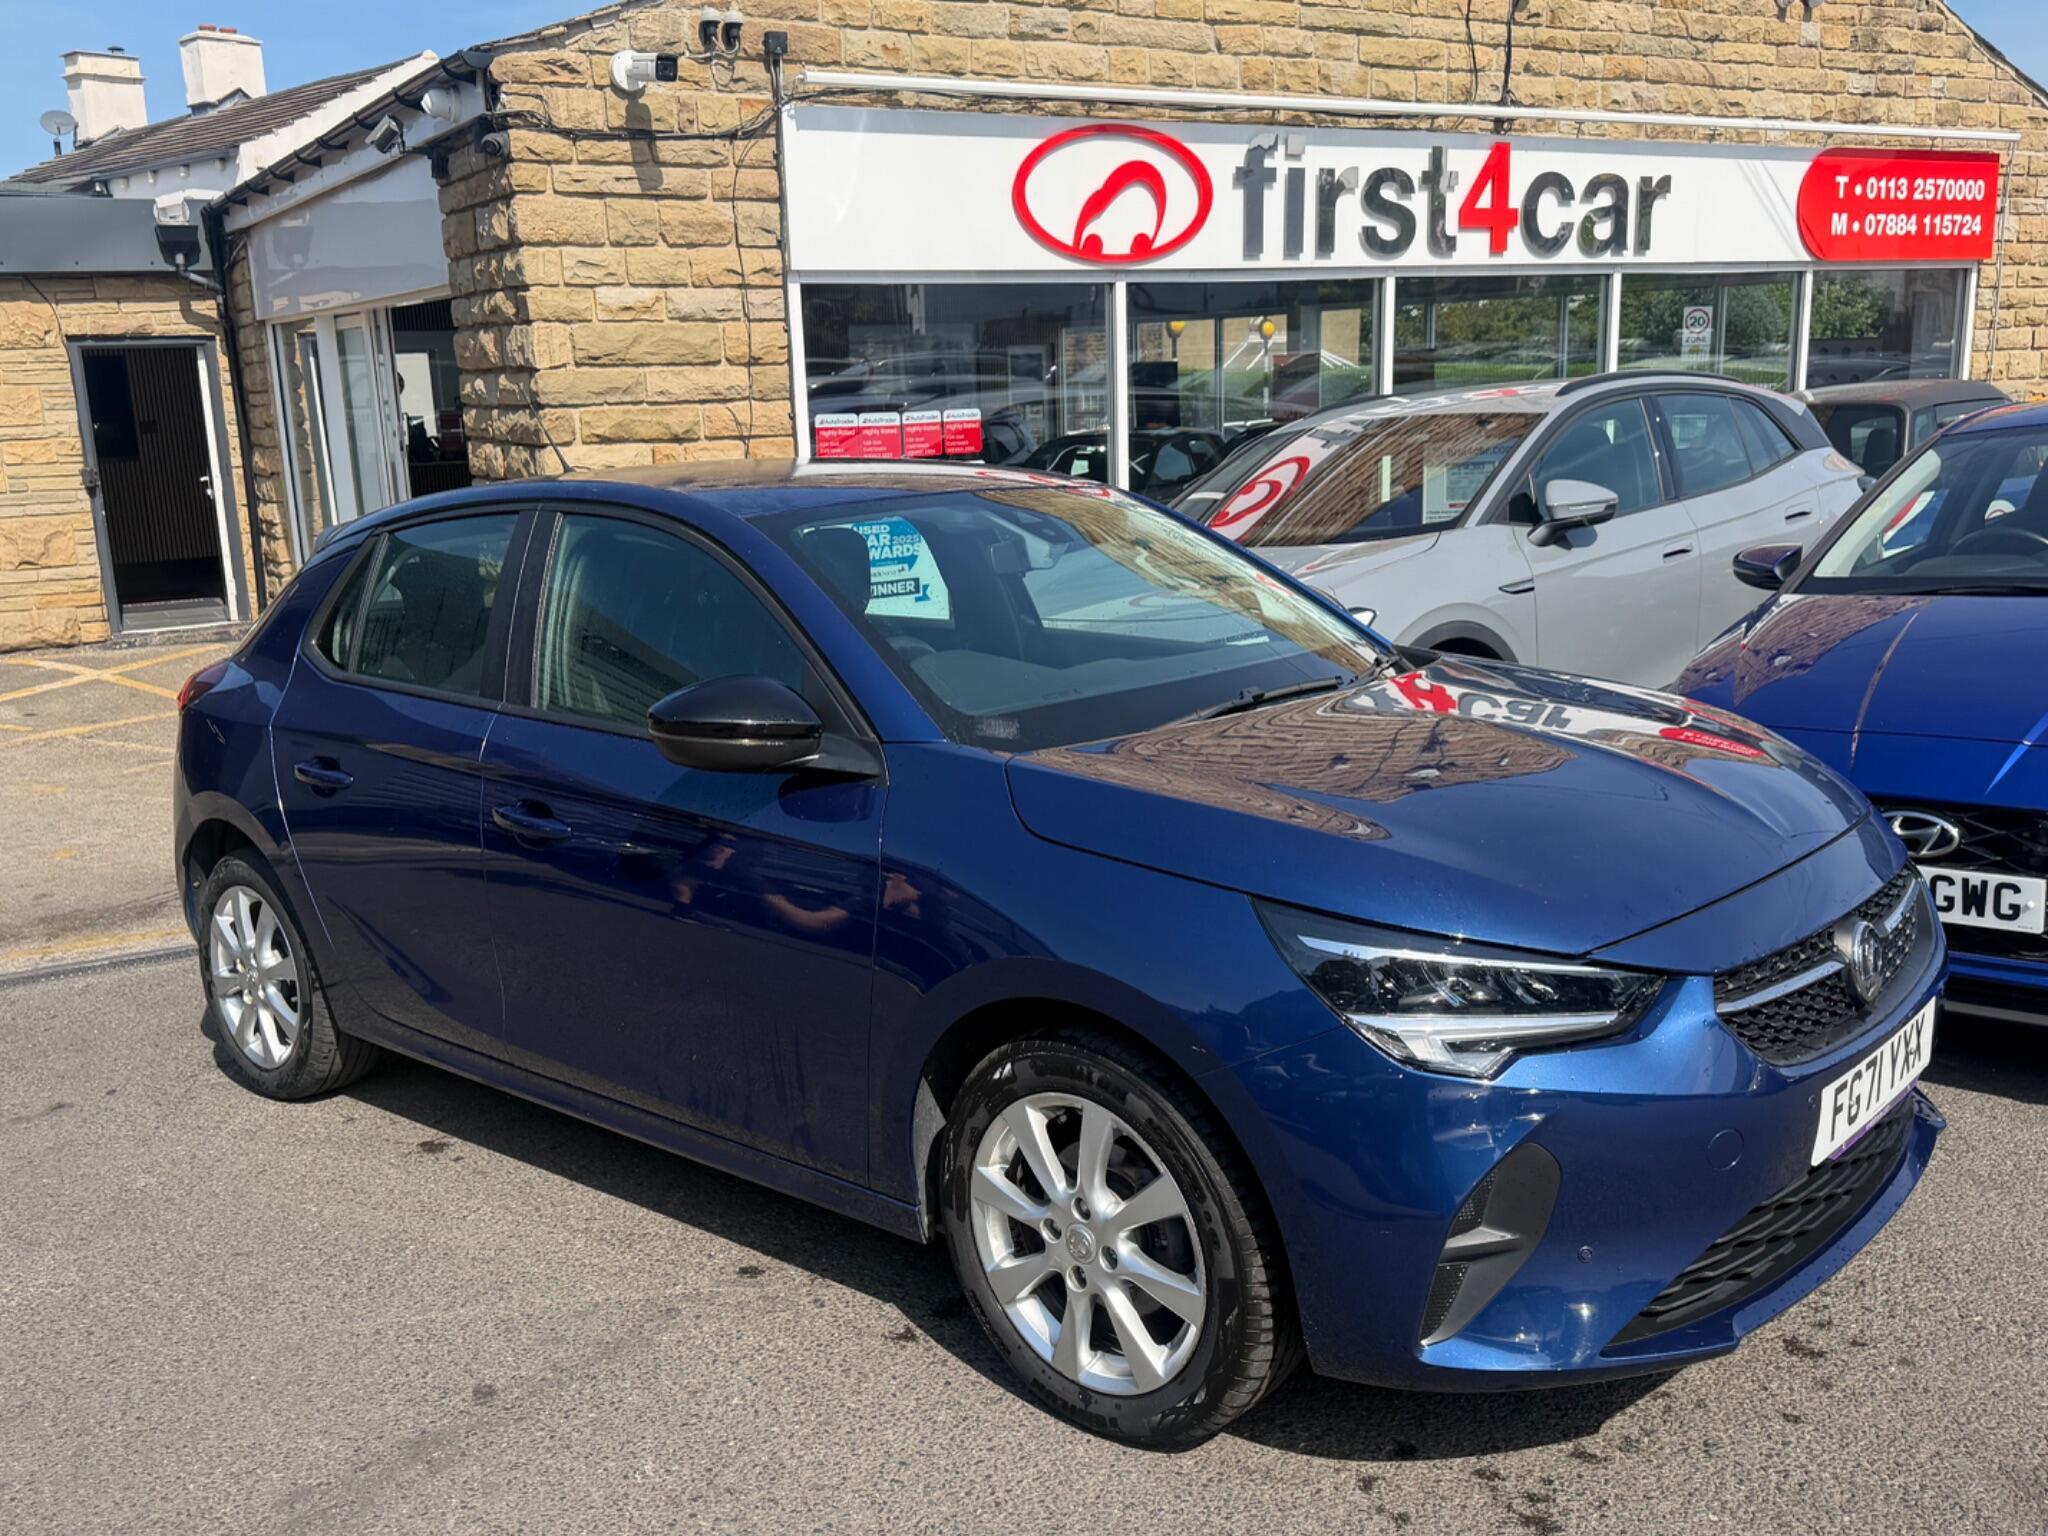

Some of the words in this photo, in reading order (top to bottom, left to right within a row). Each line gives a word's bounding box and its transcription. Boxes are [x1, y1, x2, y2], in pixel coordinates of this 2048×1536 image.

[1232, 133, 1672, 259] first4car
[1835, 176, 1849, 199] T
[1866, 177, 1908, 200] 0113
[1913, 178, 1985, 201] 2570000
[1831, 213, 1848, 236] M
[1865, 213, 1917, 236] 07884
[1923, 214, 1982, 236] 115724
[1689, 316, 1706, 327] 20
[864, 534, 892, 547] AR
[869, 544, 921, 561] WARDS
[1929, 874, 2022, 922] GWG
